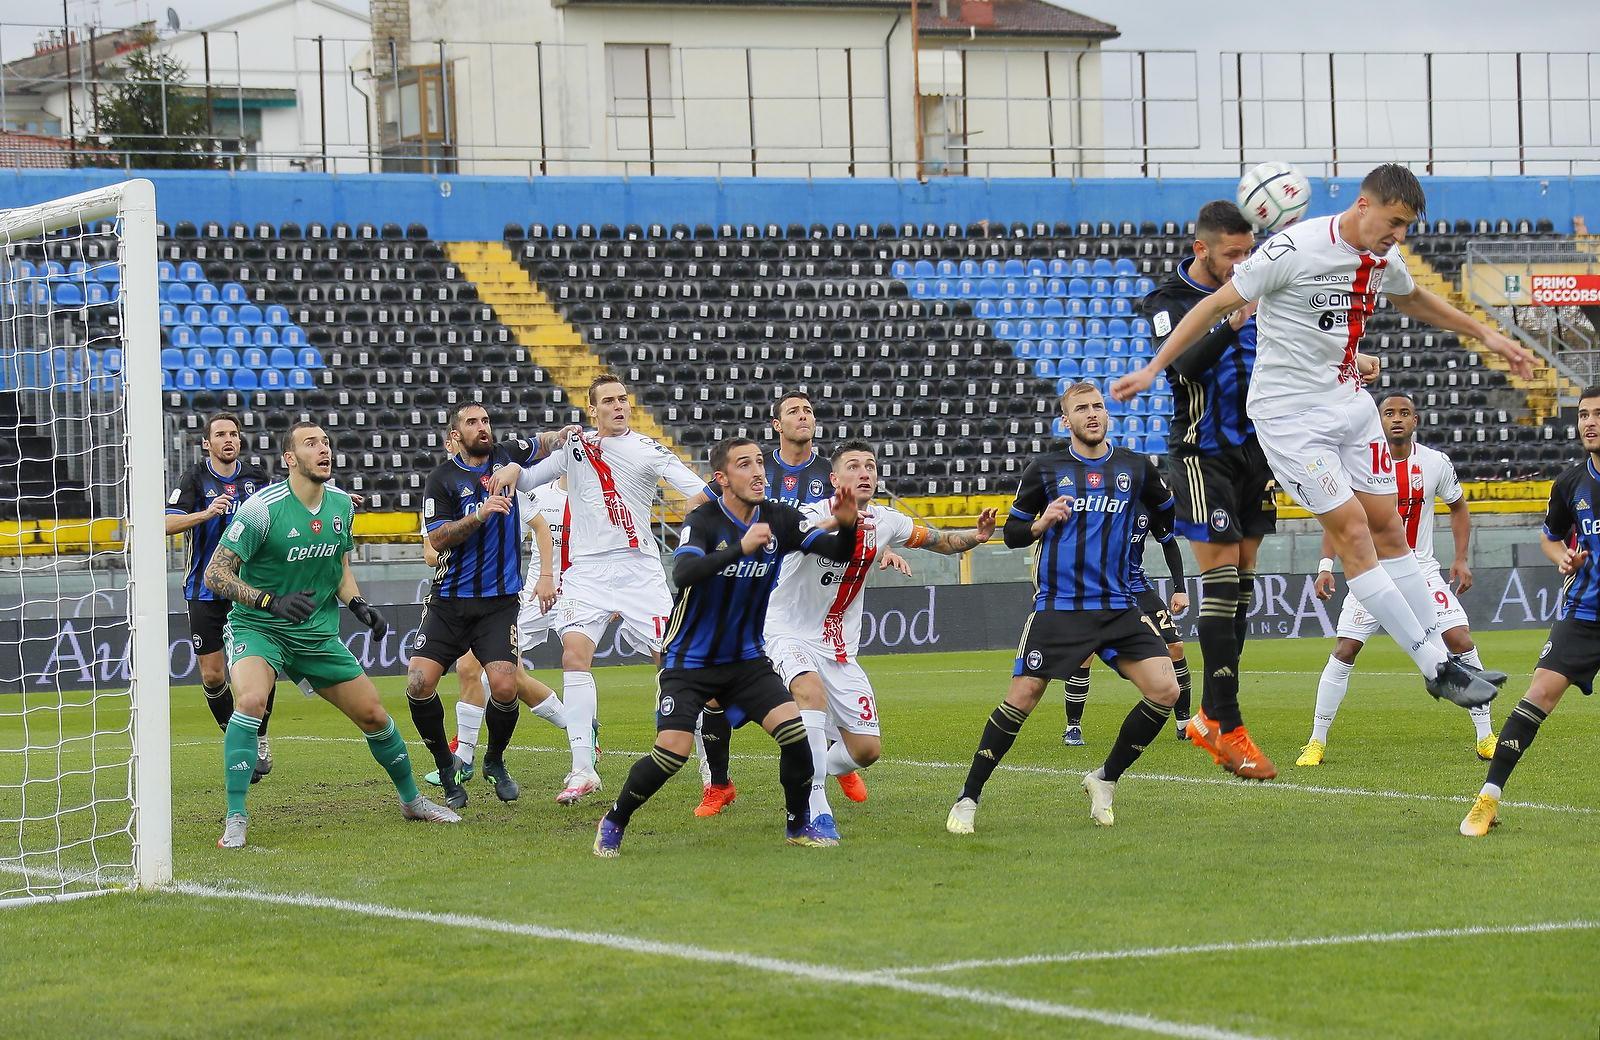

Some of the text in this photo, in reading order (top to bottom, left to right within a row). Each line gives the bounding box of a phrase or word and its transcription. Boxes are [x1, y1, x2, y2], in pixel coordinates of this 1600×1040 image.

[1533, 276, 1577, 289] PRIMO
[1533, 289, 1600, 302] SOCCORS
[1369, 441, 1392, 475] 16
[1070, 494, 1129, 514] etilar
[1581, 518, 1600, 536] Ce
[286, 540, 341, 562] Cetilar
[717, 559, 776, 578] etilar
[1434, 590, 1449, 609] 9
[859, 586, 940, 647] ood
